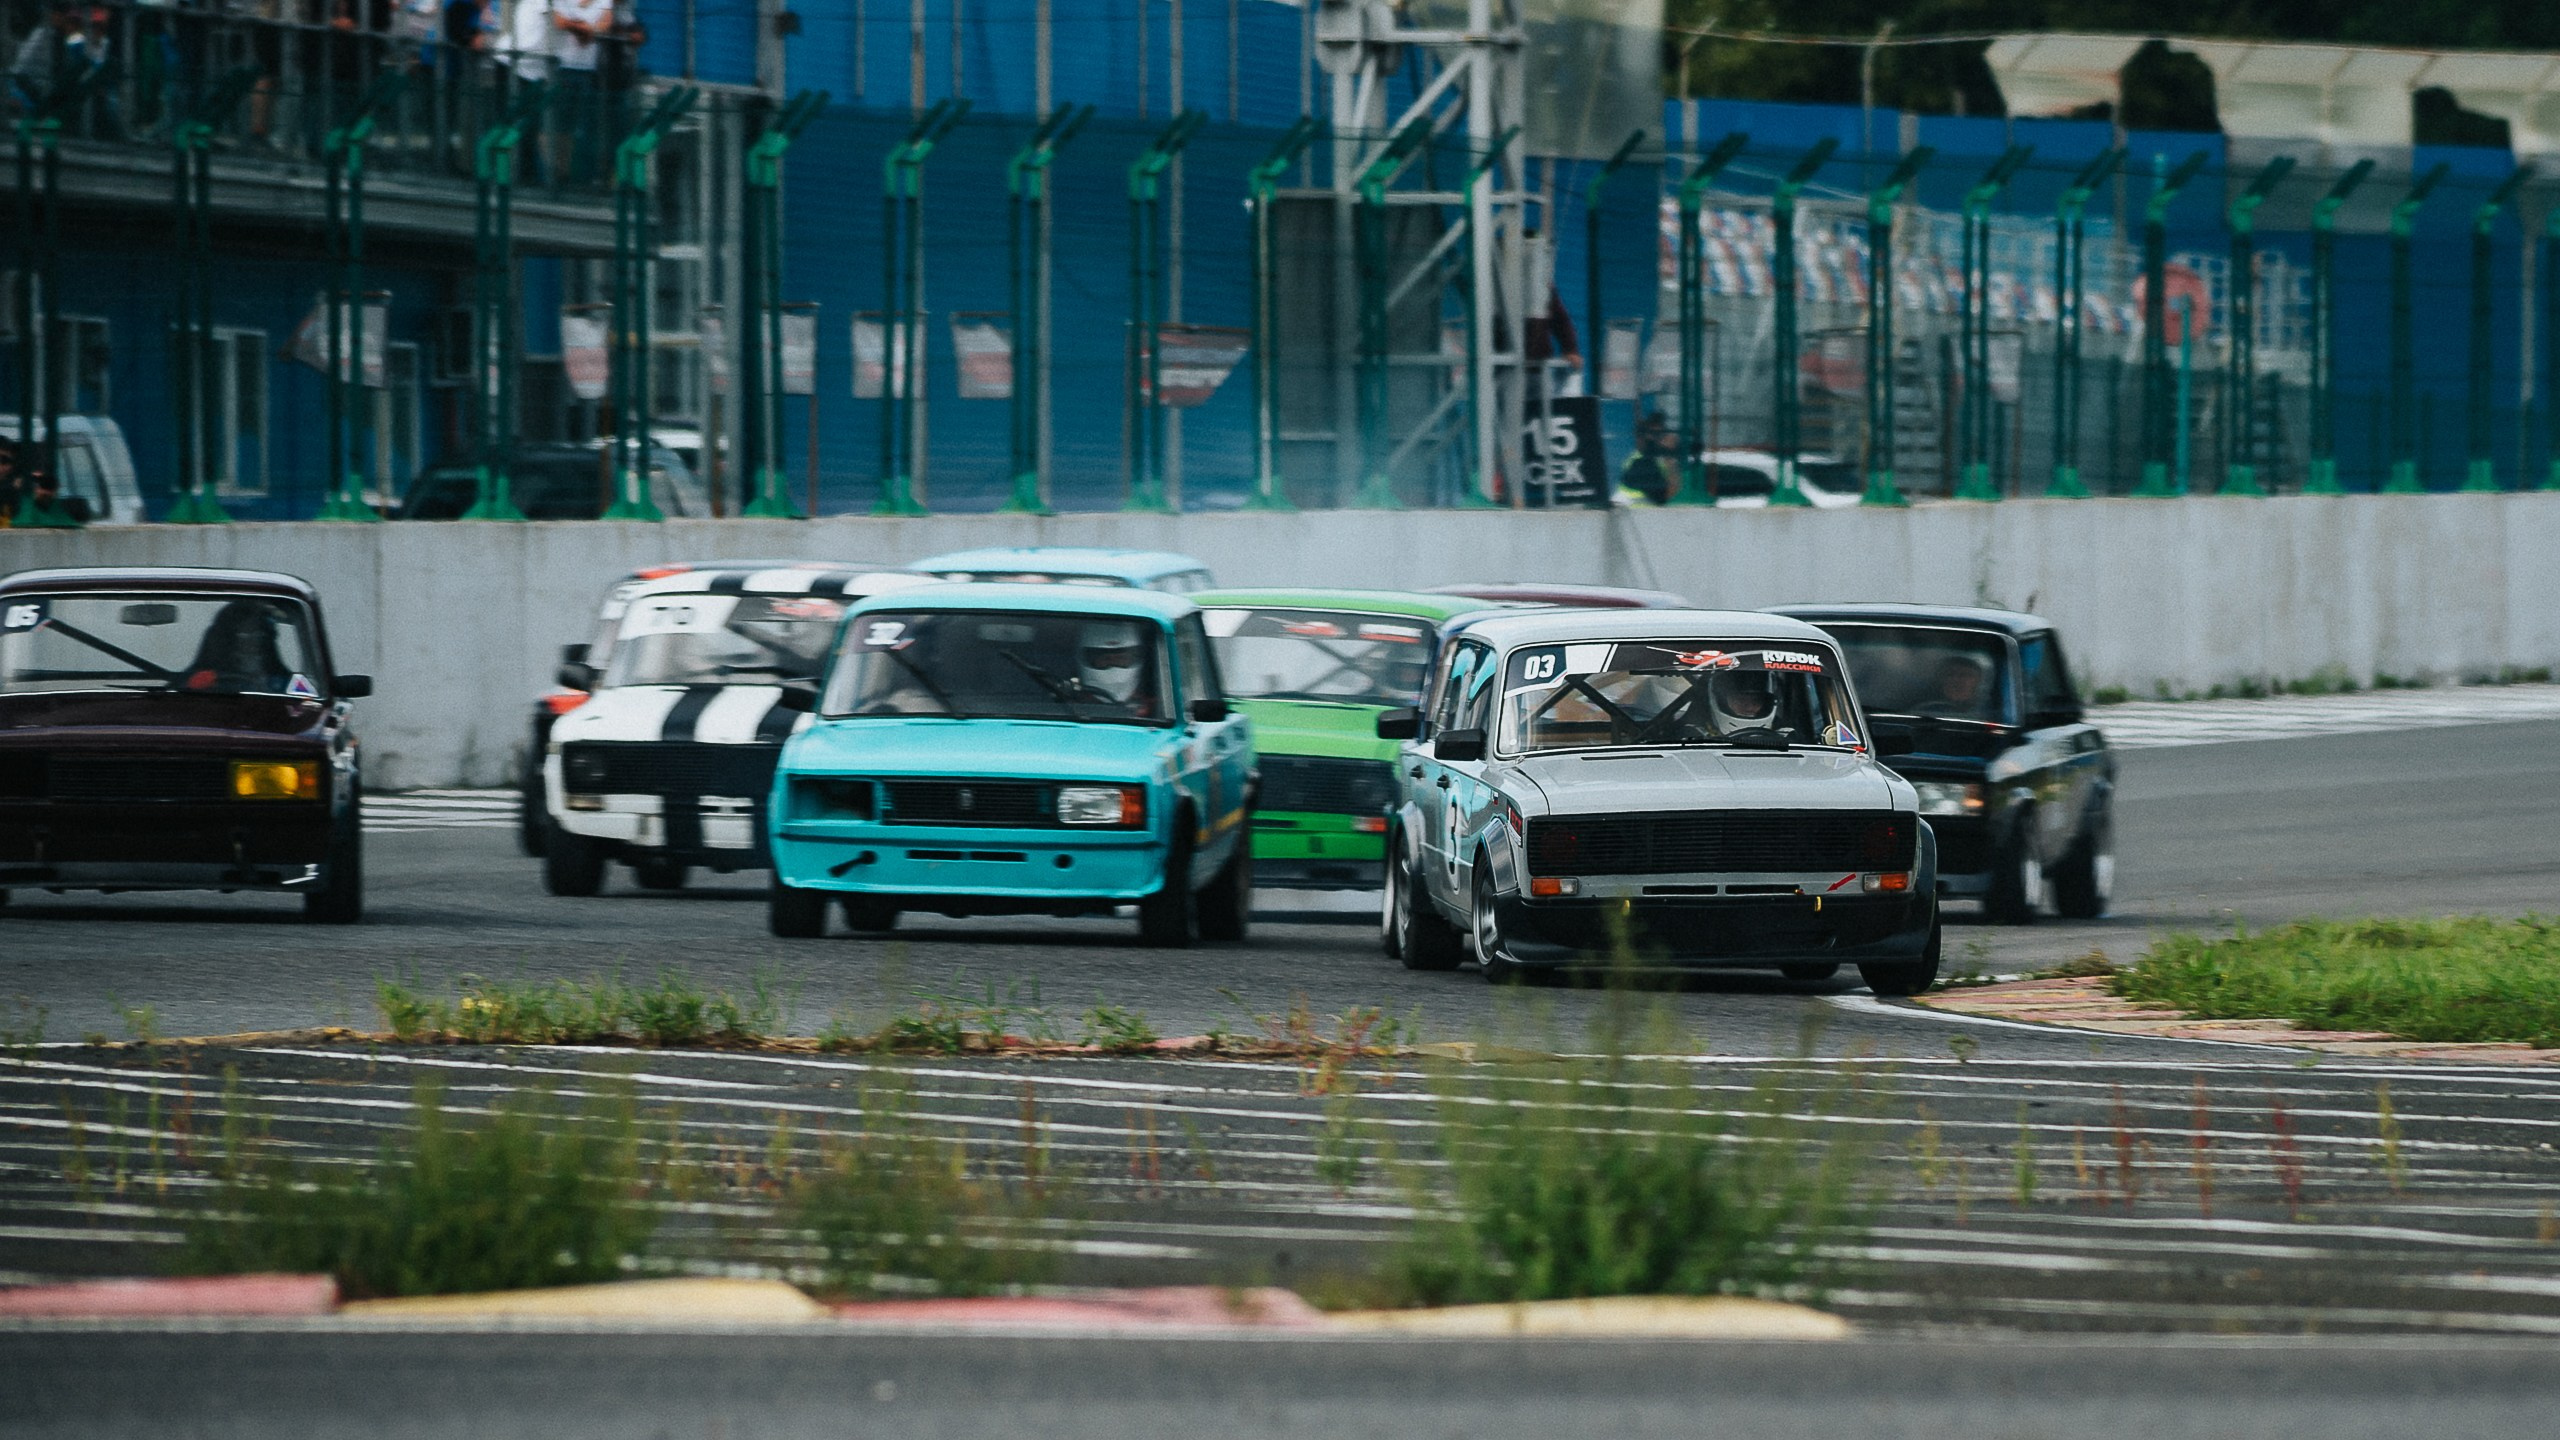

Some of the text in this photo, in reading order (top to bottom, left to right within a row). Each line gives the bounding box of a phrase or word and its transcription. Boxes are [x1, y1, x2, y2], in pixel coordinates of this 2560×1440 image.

[1523, 415, 1578, 456] 15
[1524, 654, 1556, 680] 03
[1762, 650, 1823, 666] КУБОК
[1764, 662, 1822, 673] КЛАССИКИ
